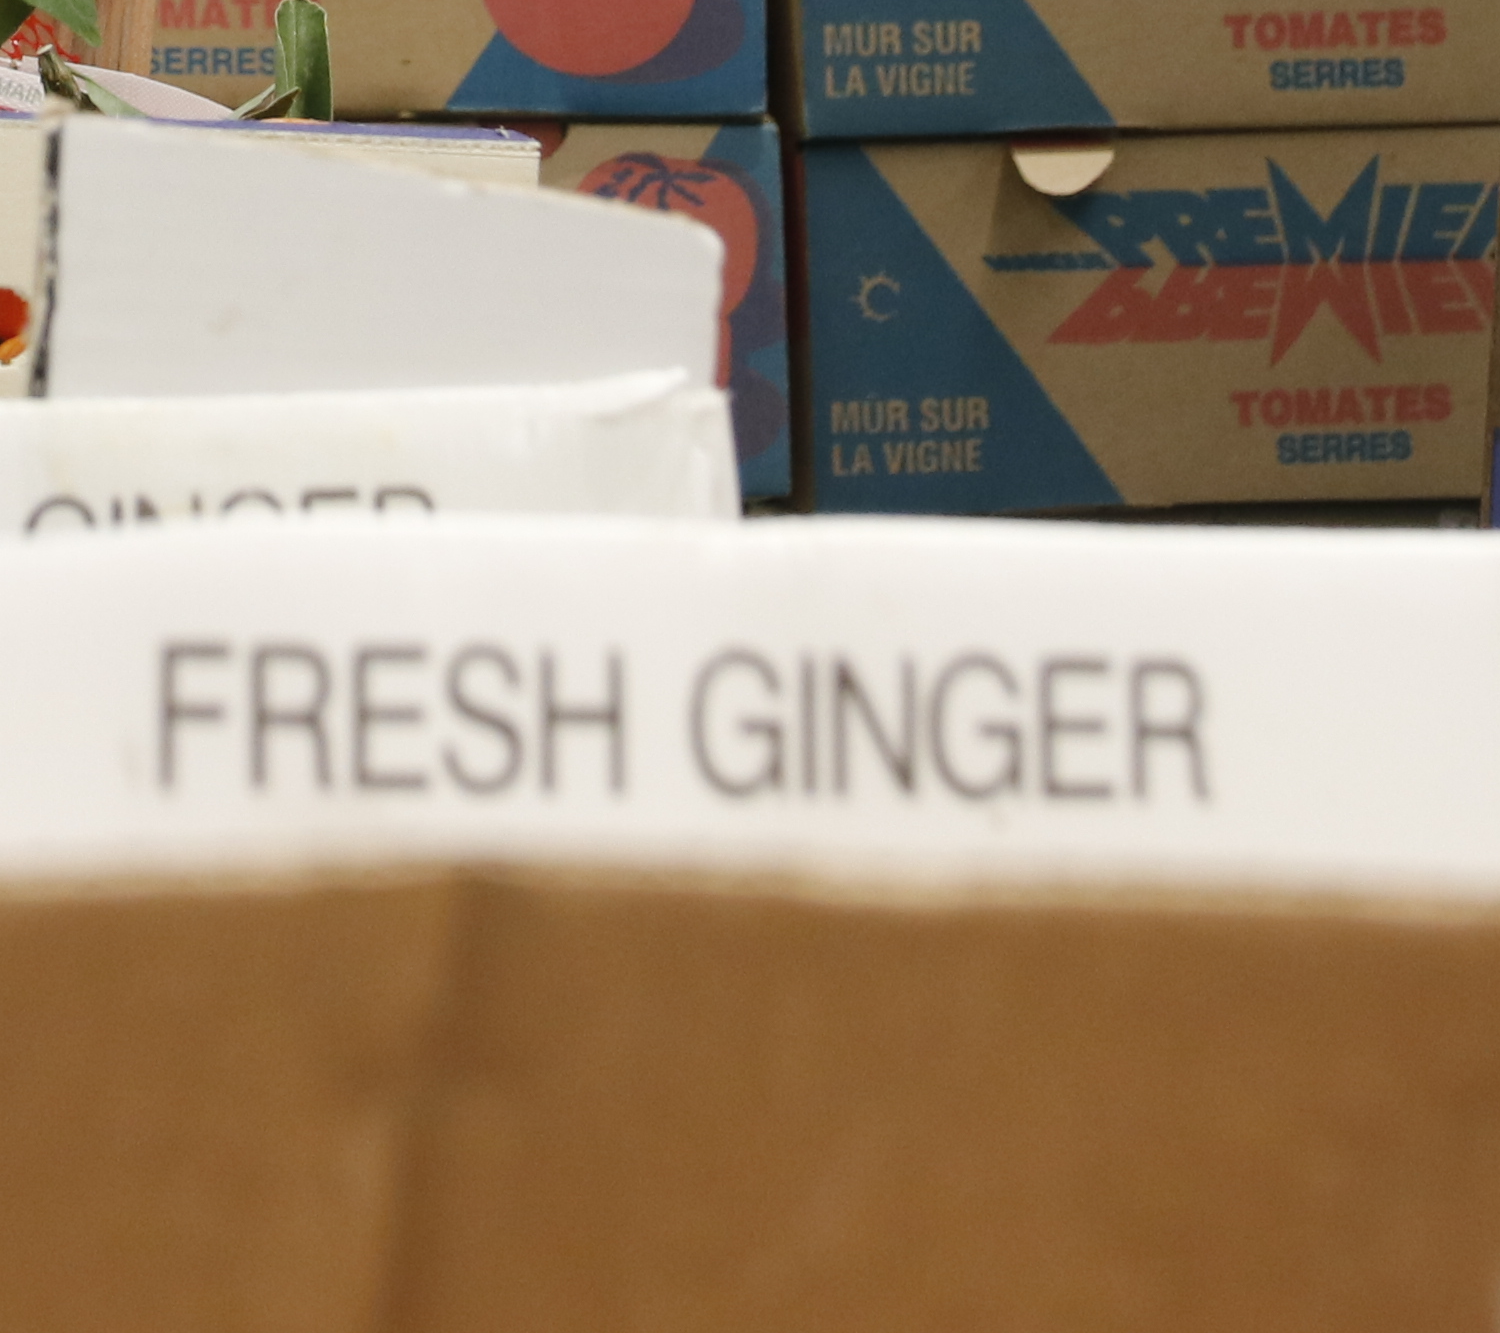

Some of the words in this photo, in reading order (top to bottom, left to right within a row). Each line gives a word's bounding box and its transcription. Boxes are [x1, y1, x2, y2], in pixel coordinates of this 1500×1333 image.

[912, 19, 982, 56] SUR
[1223, 8, 1449, 51] TOMATES
[825, 65, 867, 99] LA
[876, 61, 977, 98] VIGNE
[1268, 57, 1407, 92] SERRES
[919, 396, 990, 432] SUR
[1230, 383, 1454, 429] TOMATES
[832, 443, 874, 478] LA
[883, 438, 984, 475] VIGNE
[1275, 430, 1414, 466] SERRES
[154, 639, 628, 799] FRESH
[686, 645, 1216, 807] GINGER
